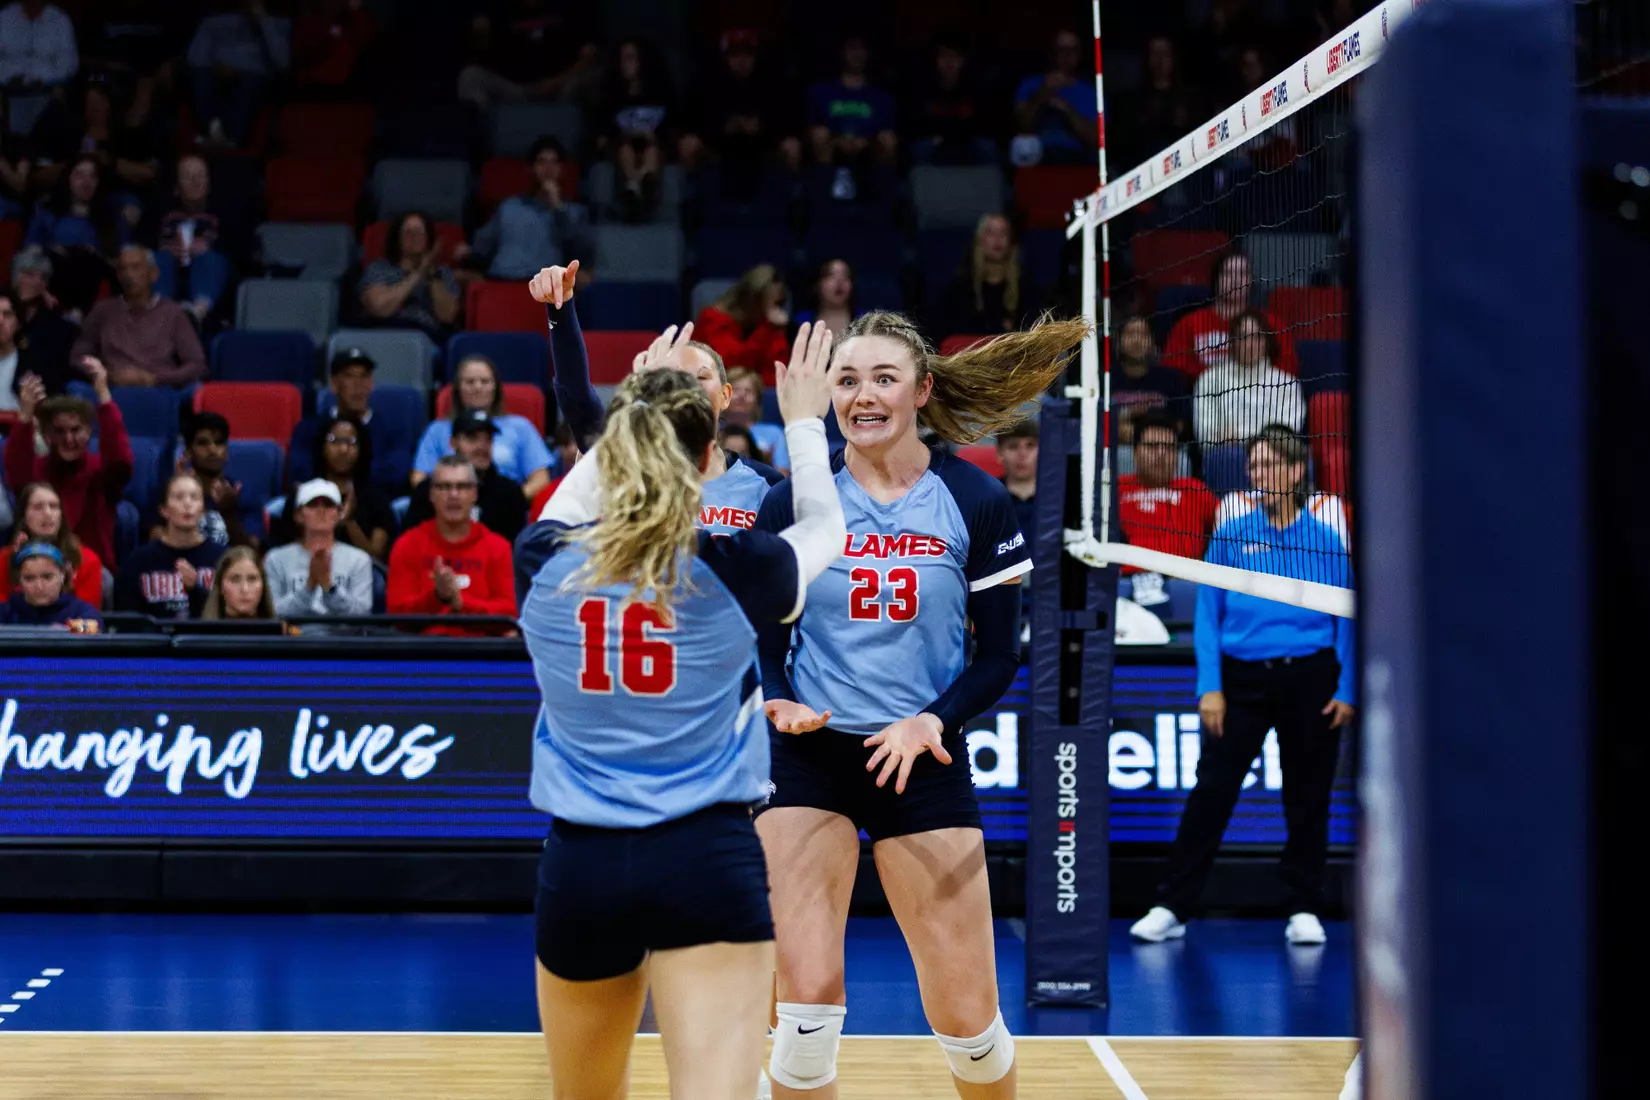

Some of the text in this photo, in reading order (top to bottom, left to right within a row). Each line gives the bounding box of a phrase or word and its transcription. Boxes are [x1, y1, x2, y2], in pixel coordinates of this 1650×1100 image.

[698, 504, 757, 531] AMES
[843, 532, 947, 559] LAMES
[848, 565, 920, 623] 23
[575, 596, 678, 697] 16
[0, 698, 456, 799] hanging lives
[1054, 742, 1080, 818] sports
